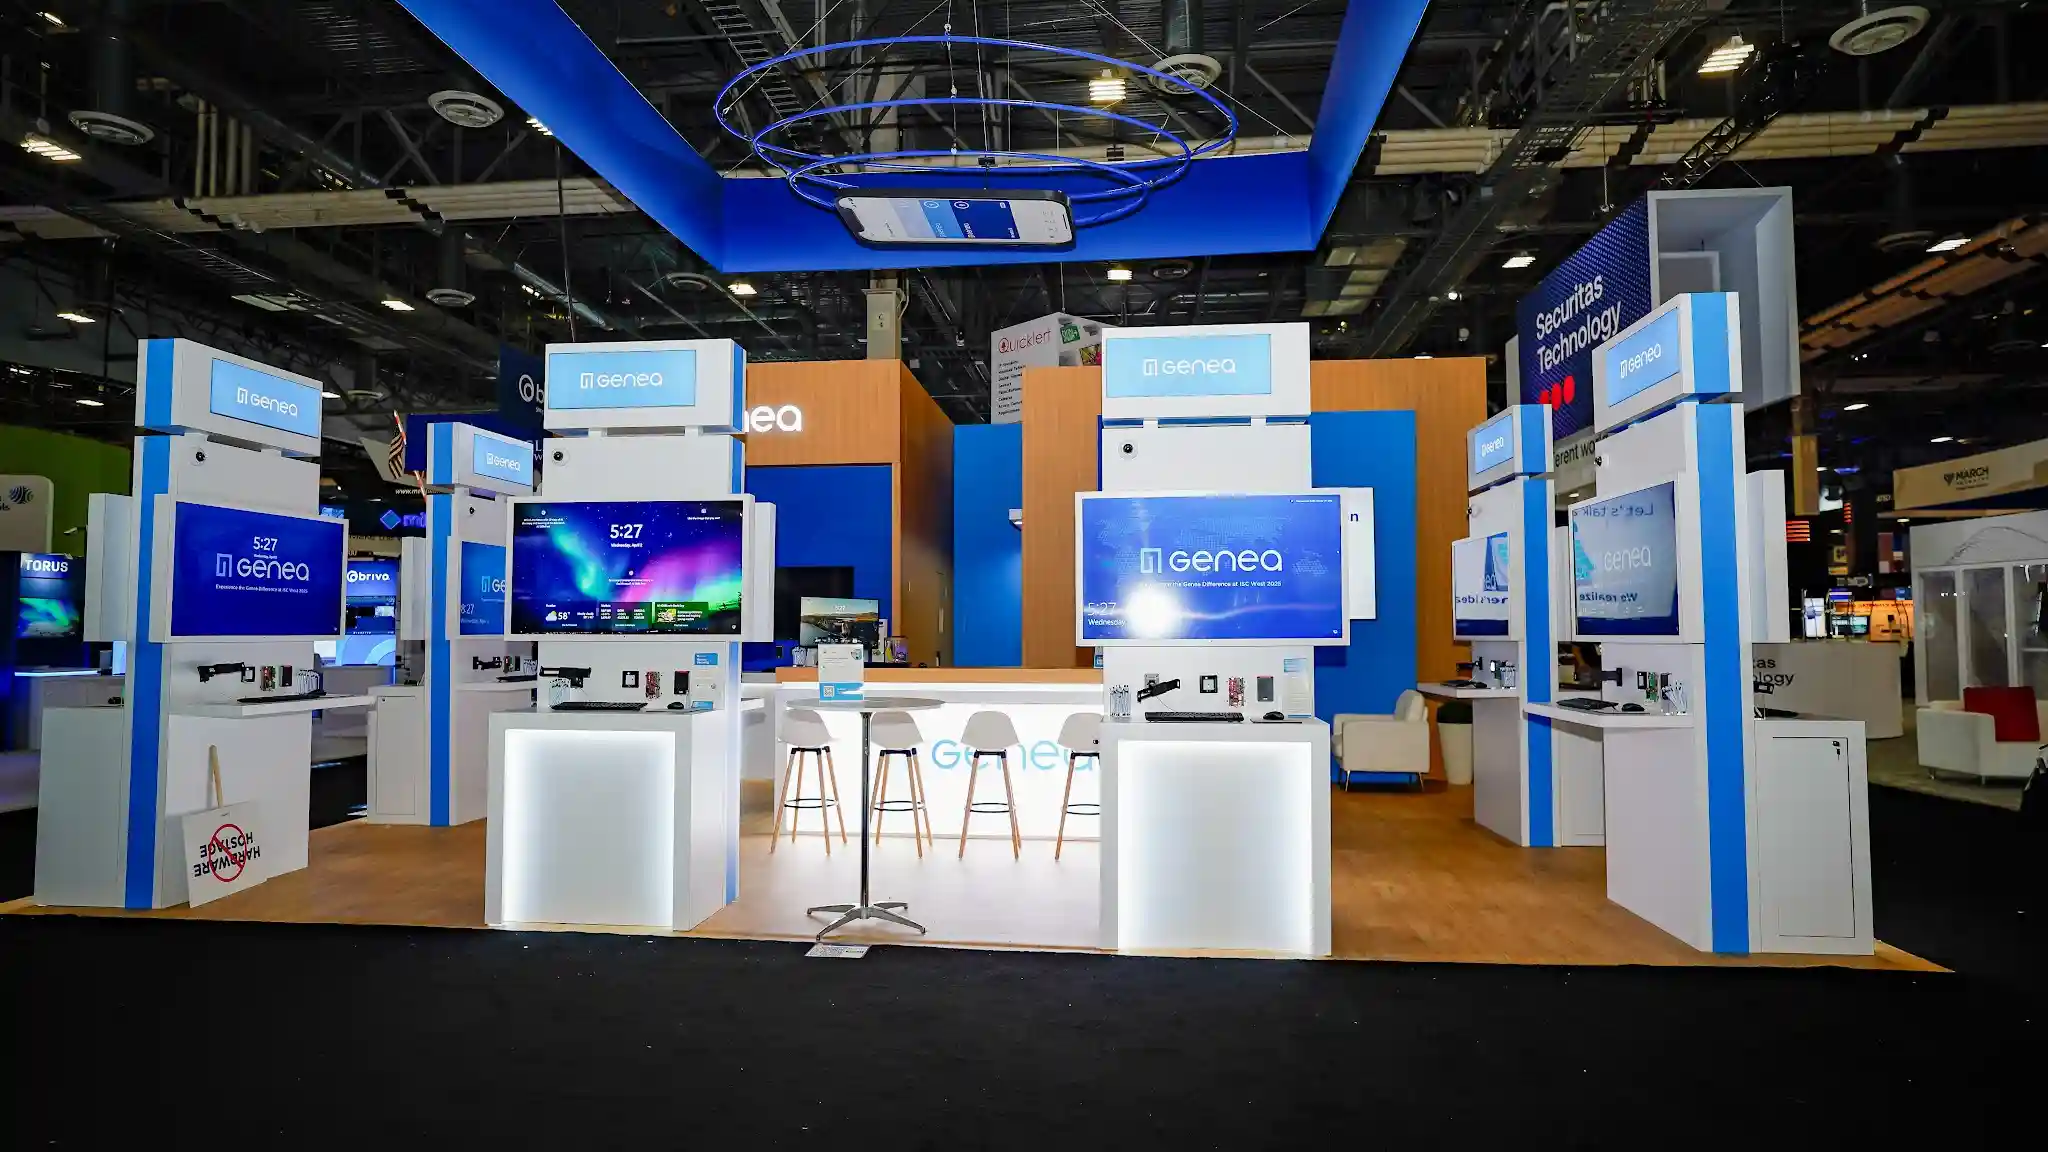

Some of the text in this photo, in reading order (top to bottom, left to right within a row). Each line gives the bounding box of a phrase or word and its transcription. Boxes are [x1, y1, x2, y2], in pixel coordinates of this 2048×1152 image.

[1536, 275, 1603, 340] Securitas
[998, 327, 1052, 354] Quicklert
[1537, 300, 1621, 374] Technology
[1162, 358, 1237, 375] Genea
[597, 372, 663, 388] Genea
[250, 393, 298, 419] Genea
[610, 523, 644, 539] 5:27
[252, 536, 278, 551] 5:27
[25, 559, 69, 572] TORUS
[236, 557, 310, 581] Genea
[1169, 549, 1283, 572] Genea
[1088, 602, 1117, 616] 5:27
[199, 832, 254, 858] HOSTAGE
[193, 846, 261, 877] HARDWARE
